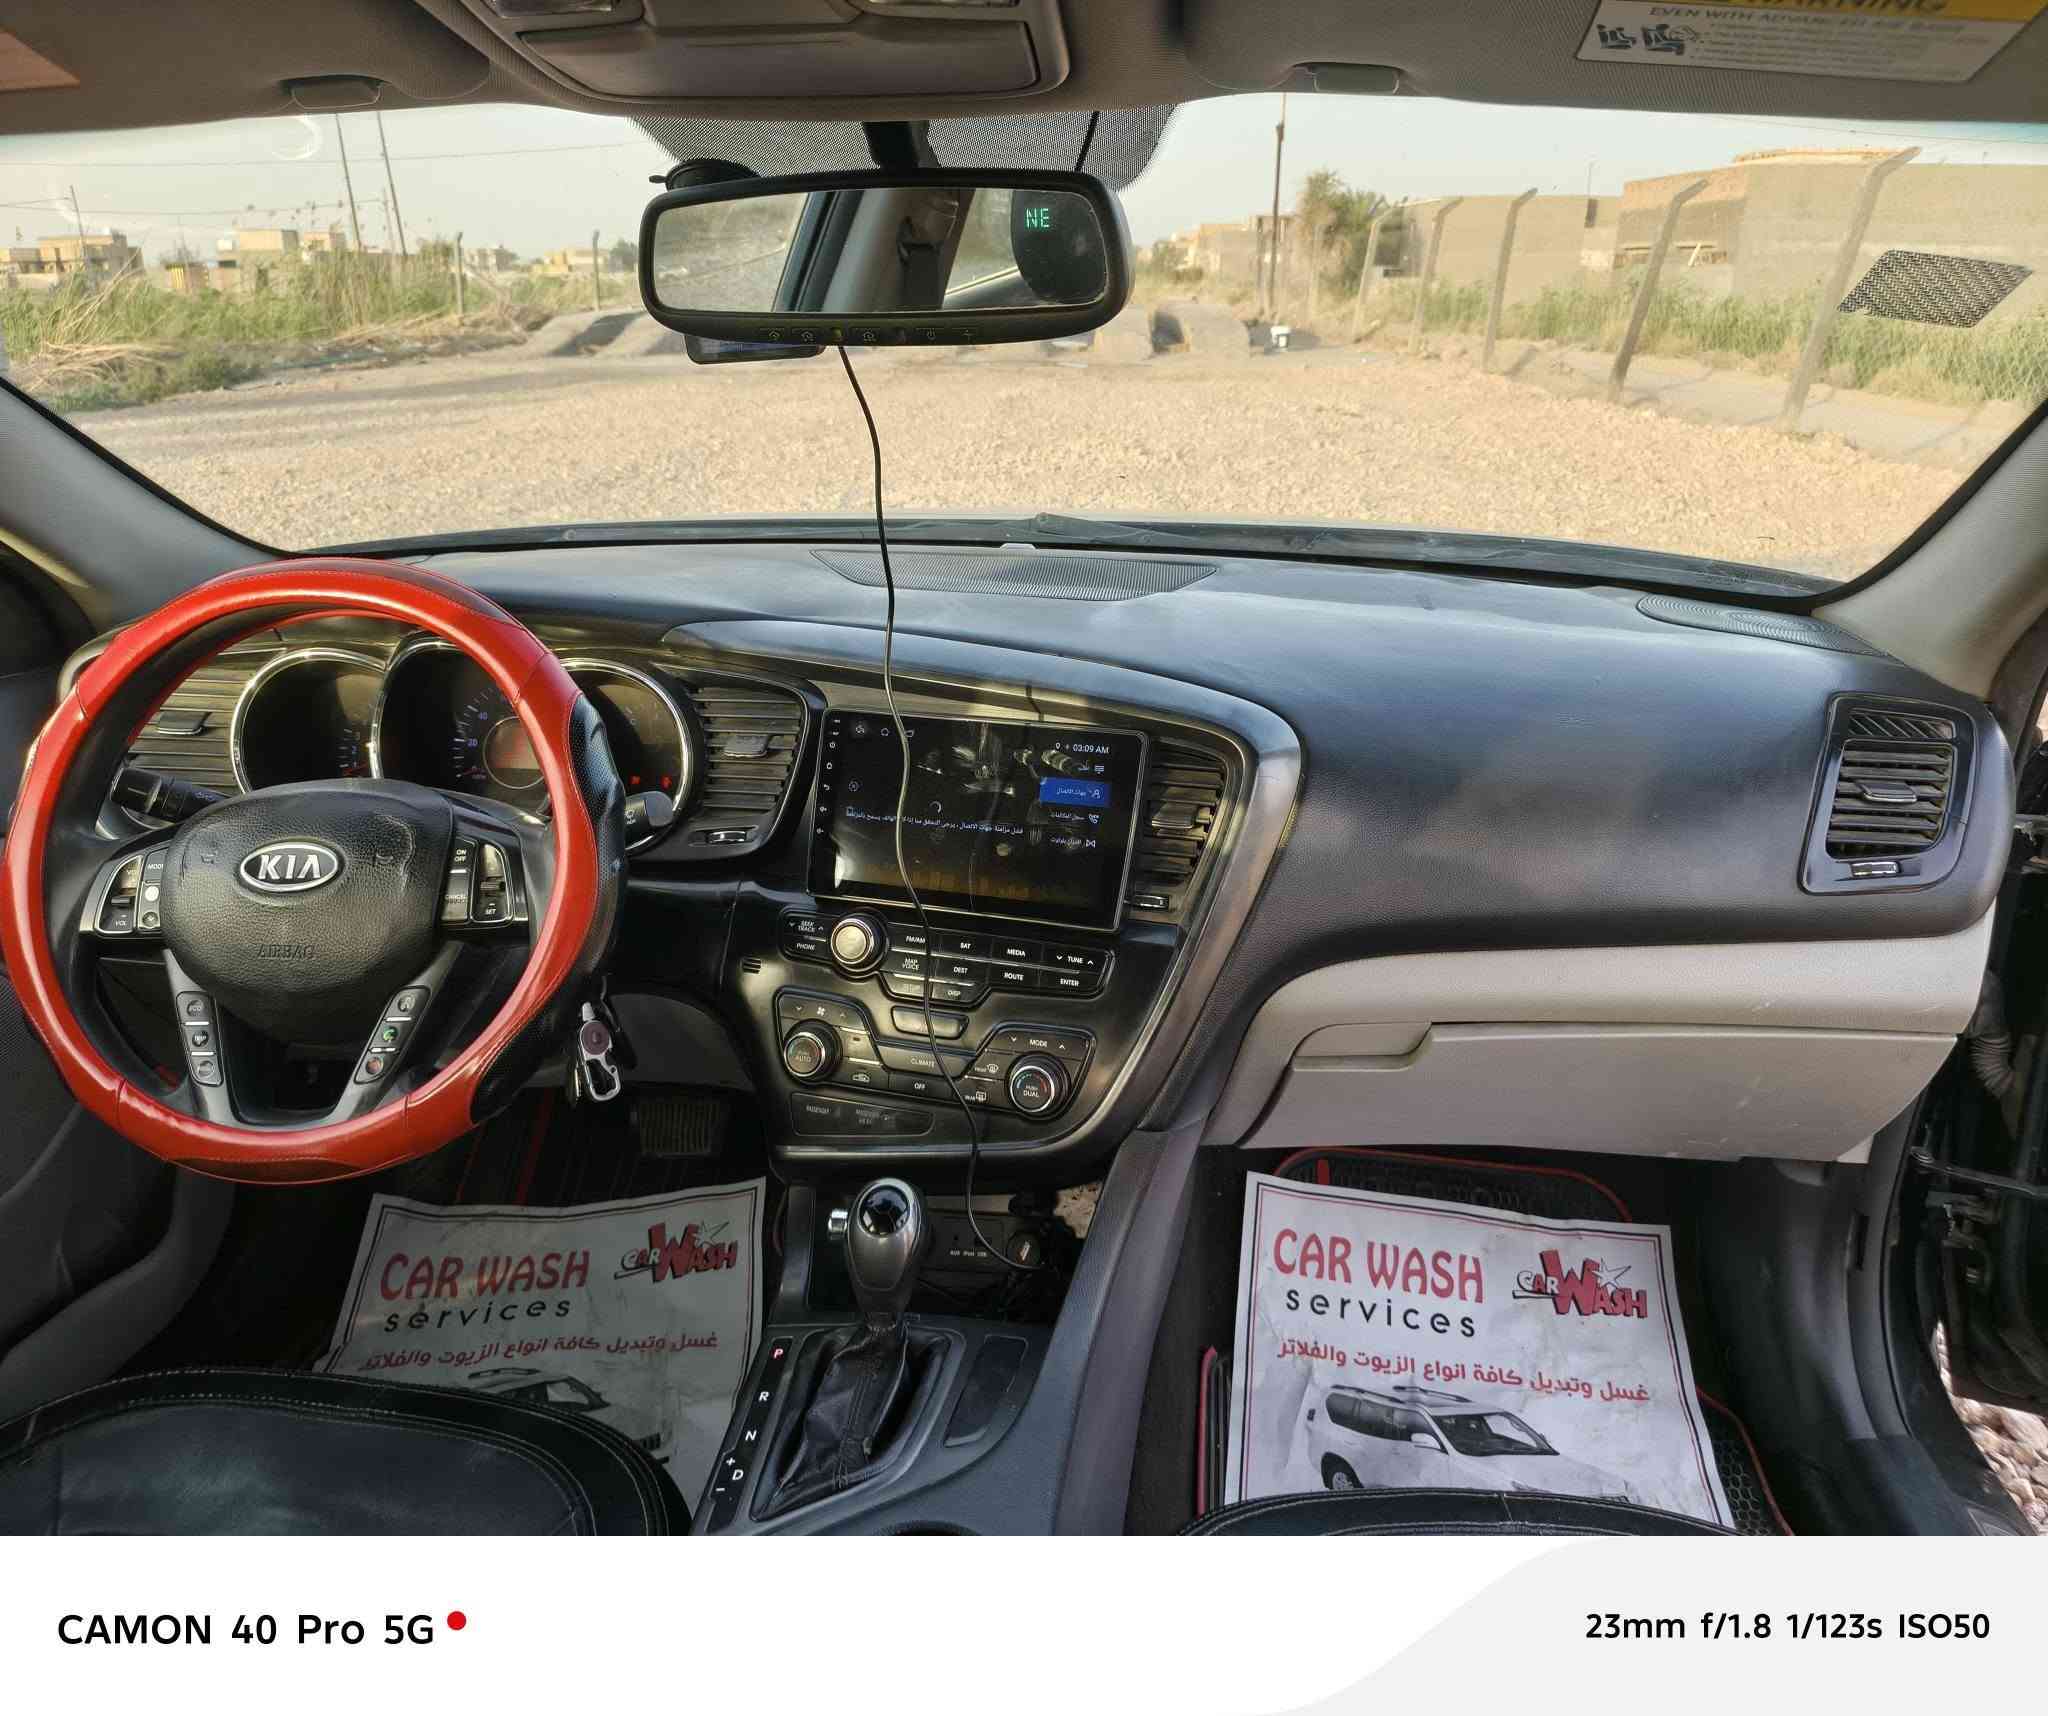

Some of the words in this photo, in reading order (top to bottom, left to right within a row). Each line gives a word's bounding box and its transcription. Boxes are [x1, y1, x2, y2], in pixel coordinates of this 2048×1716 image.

[1648, 7, 1701, 17] EVEN
[1705, 9, 1752, 20] WITH
[1025, 208, 1050, 228] NE
[1073, 743, 1094, 753] 03:09
[1095, 745, 1109, 754] AM
[258, 854, 321, 880] KIA
[796, 942, 816, 951] PHONE
[960, 942, 972, 950] SAT
[1007, 948, 1026, 958] MEDIA
[1067, 955, 1083, 964] TUNE
[953, 966, 969, 975] DEST
[1003, 972, 1024, 982] ROUTE
[1059, 978, 1080, 987] ENTER
[1029, 1039, 1048, 1048] MODE
[1023, 1090, 1040, 1098] DUAL
[621, 1247, 660, 1271] CAR
[1273, 1228, 1352, 1284] CAR
[1366, 1241, 1483, 1304] WASH
[380, 1252, 464, 1301] CAR
[475, 1249, 590, 1297] WASH
[1517, 1270, 1560, 1295] CAR
[1539, 1249, 1648, 1319] WASH
[384, 1300, 571, 1333] services
[1285, 1289, 1475, 1337] services
[502, 1338, 548, 1359] انواع
[553, 1335, 600, 1352] كافة
[605, 1335, 666, 1353] وتبديل
[671, 1331, 720, 1352] غسل
[436, 1343, 499, 1367] الزيوت
[773, 1348, 784, 1359] P
[1277, 1338, 1346, 1366] والفلاتر
[1354, 1351, 1415, 1375] الزيوت
[1423, 1362, 1466, 1382] انواع
[1473, 1364, 1523, 1387] كافة
[1530, 1371, 1593, 1399] وتبديل
[758, 1391, 769, 1402] R
[1599, 1380, 1650, 1404] غسل
[745, 1430, 757, 1441] N
[732, 1469, 744, 1481] D
